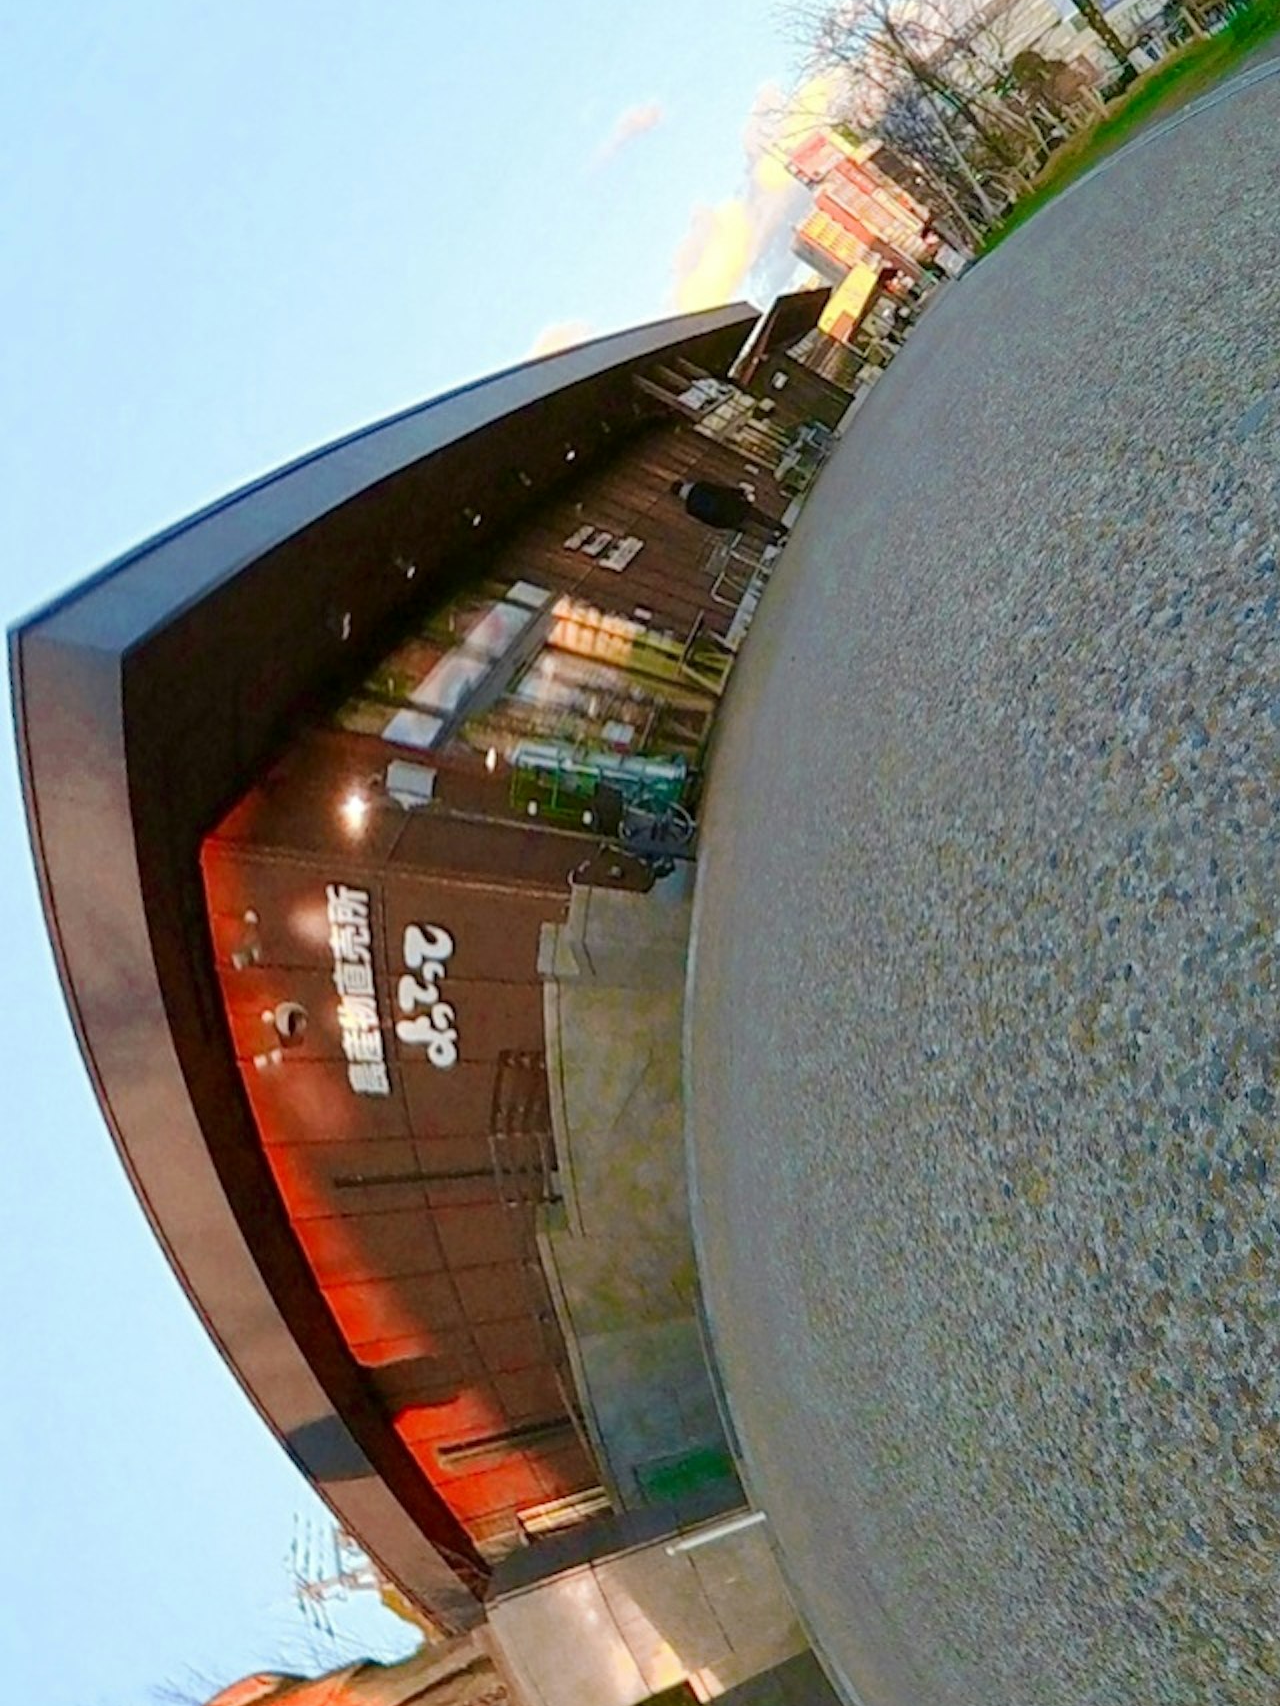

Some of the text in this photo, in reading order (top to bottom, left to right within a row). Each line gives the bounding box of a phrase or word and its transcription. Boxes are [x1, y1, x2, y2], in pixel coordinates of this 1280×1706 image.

[326, 884, 390, 1095] 農産物直売所
[396, 924, 458, 1068] よってって
